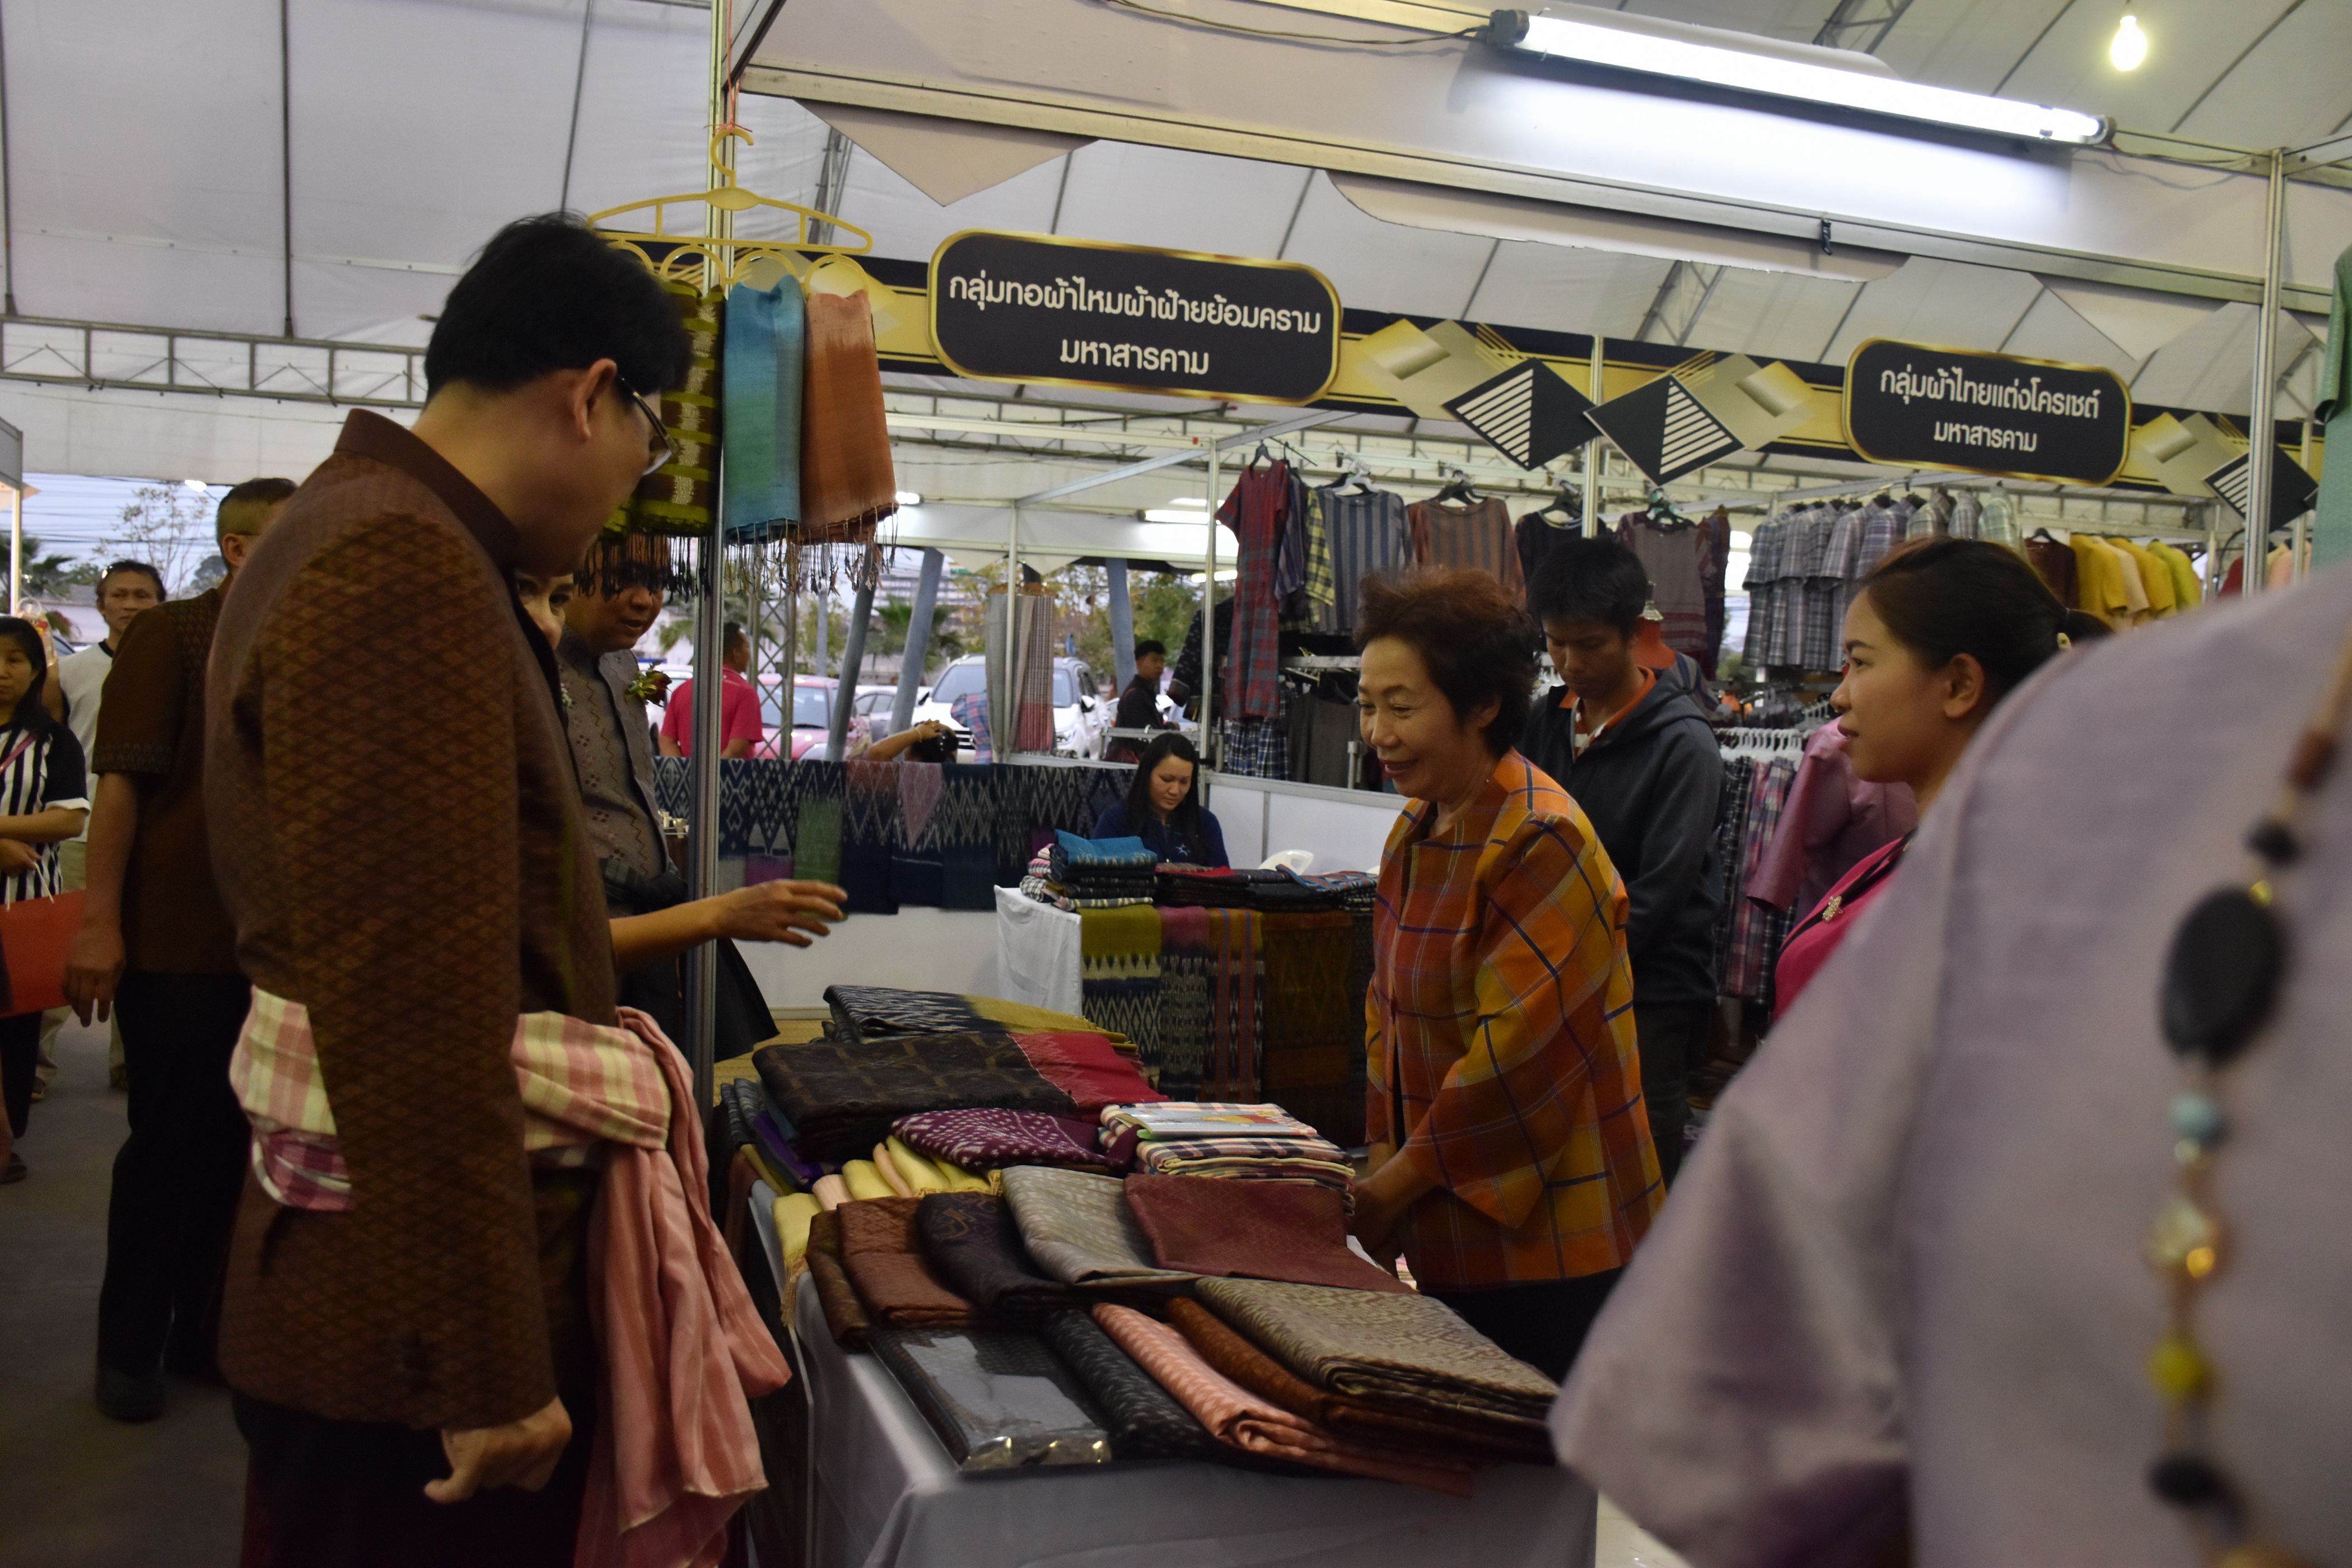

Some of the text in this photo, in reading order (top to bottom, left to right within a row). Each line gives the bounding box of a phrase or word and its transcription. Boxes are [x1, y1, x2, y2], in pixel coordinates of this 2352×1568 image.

[949, 269, 1322, 334] กลุ่มทอผ้าไหมผ้าฝ้ายย้อมคราม
[1059, 338, 1210, 375] มหาสารคาม
[1880, 363, 2102, 419] กลุ่มผ้าไทยแต่งโครเชต์
[1933, 421, 2038, 452] มหาสารคาม
